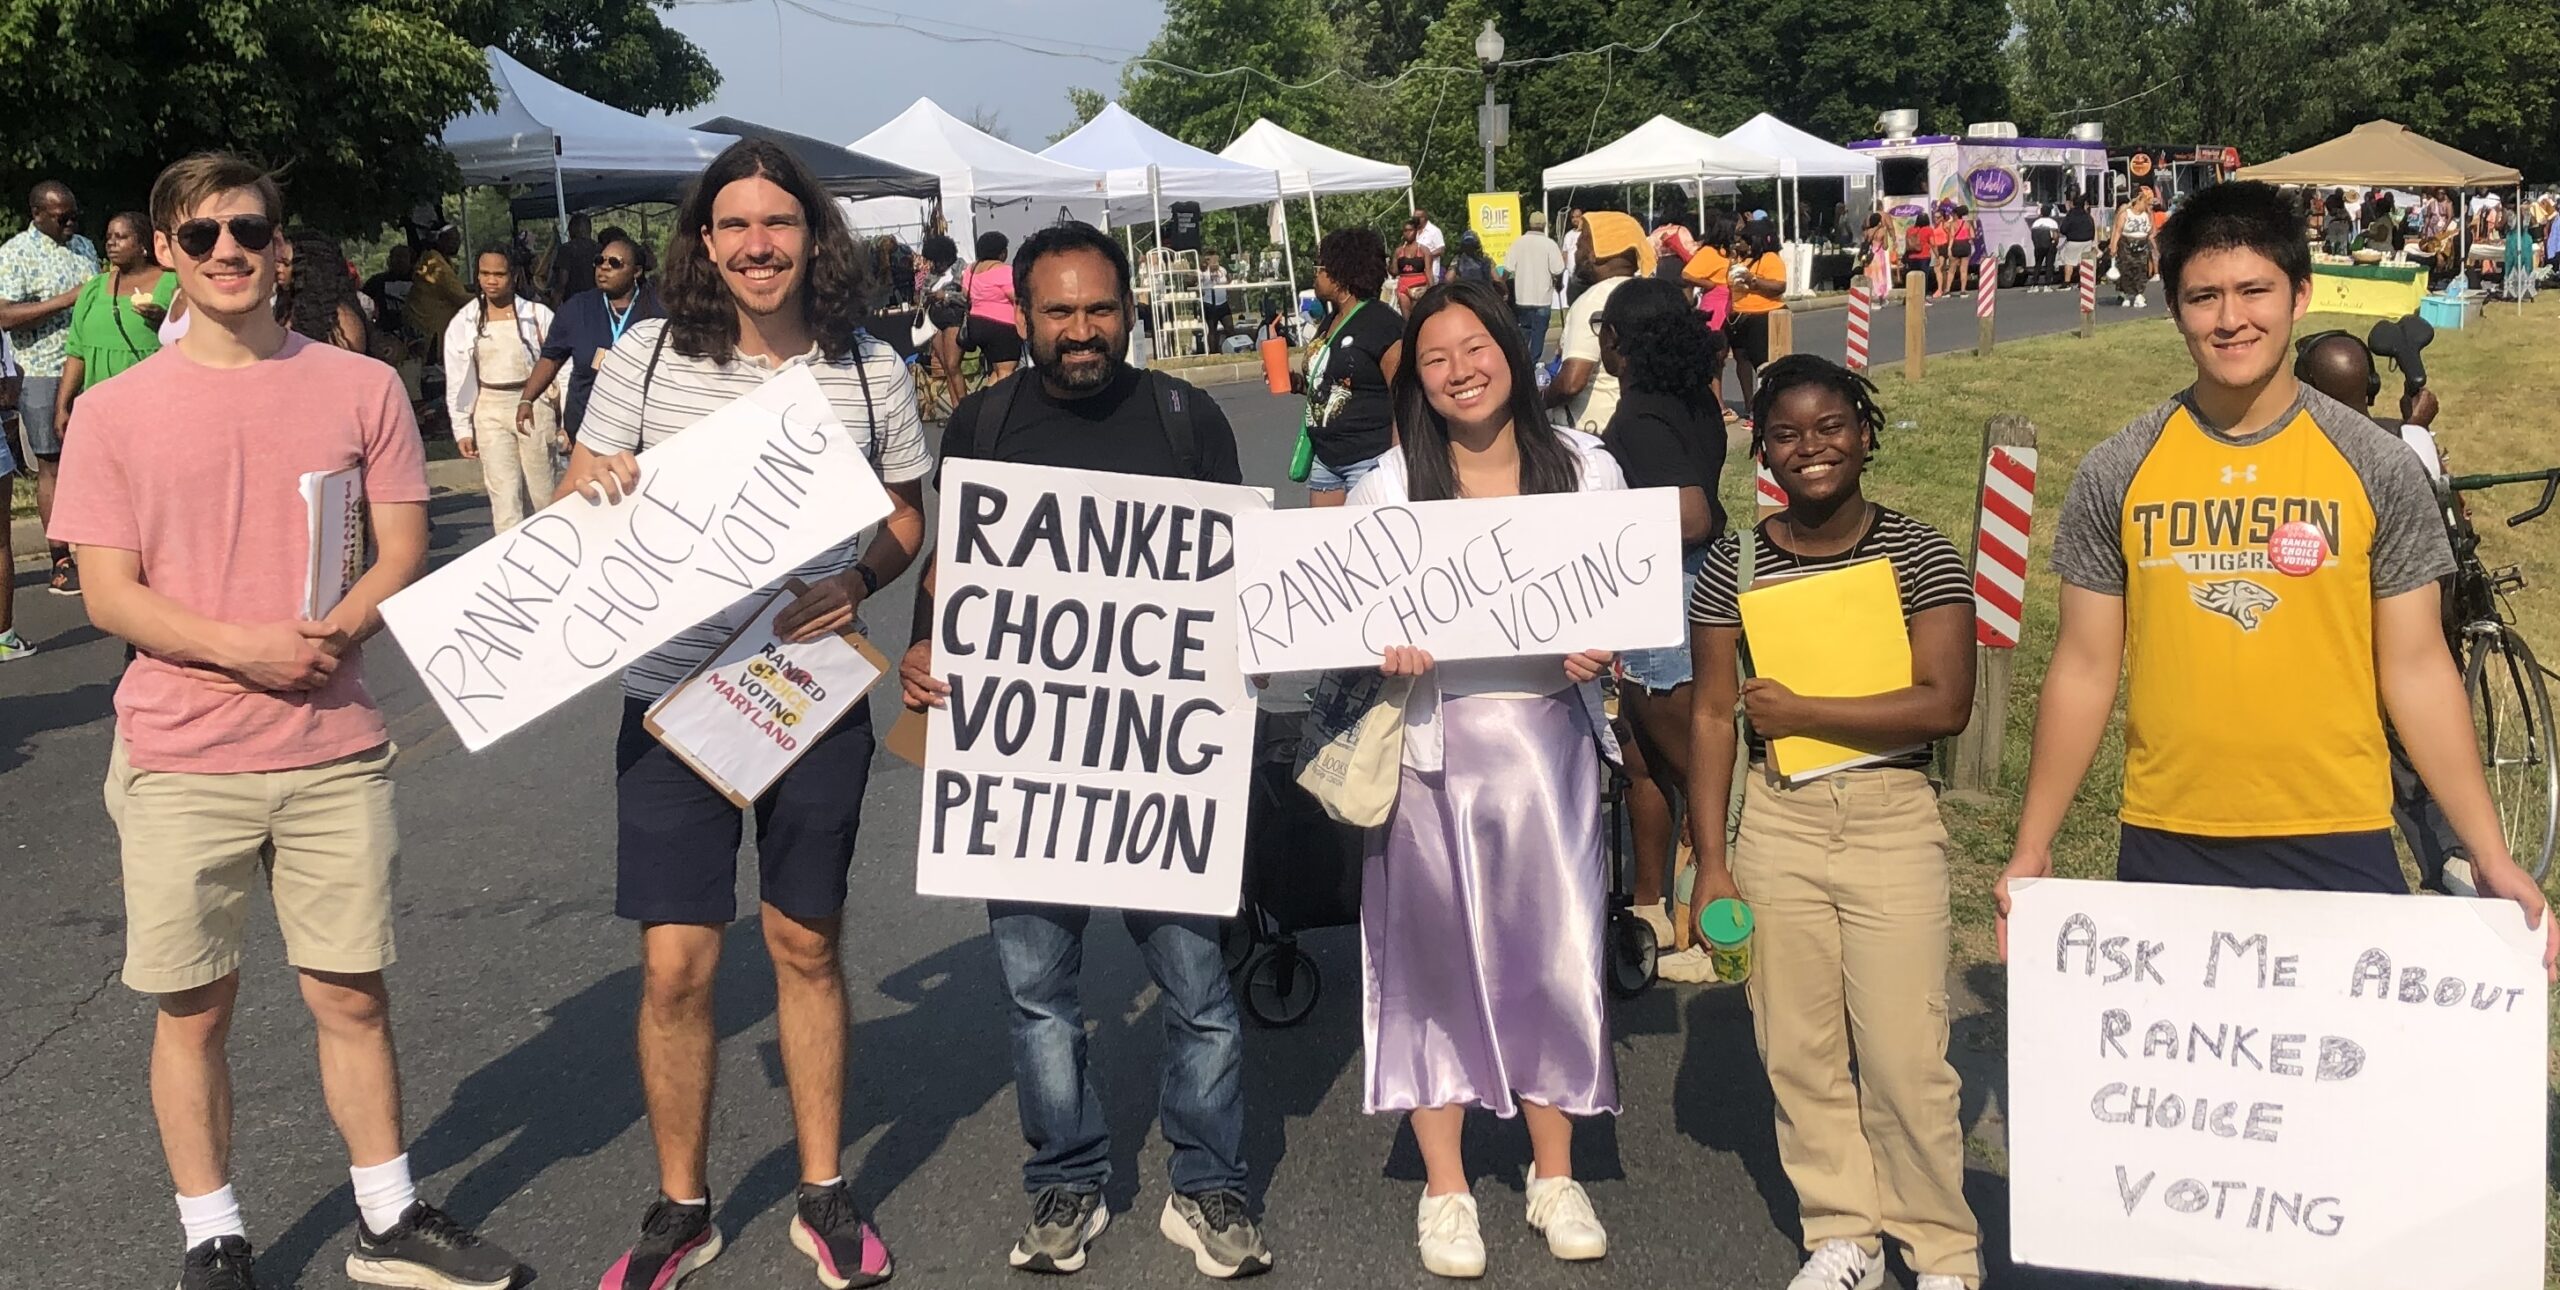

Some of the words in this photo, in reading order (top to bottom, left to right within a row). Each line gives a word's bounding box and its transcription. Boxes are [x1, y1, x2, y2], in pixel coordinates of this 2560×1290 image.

[696, 402, 828, 590] VOTING
[954, 481, 1235, 582] RANKED
[2133, 497, 2340, 557] TOWSON
[562, 468, 717, 669] CHOICE
[2187, 552, 2276, 571] TIGER
[2281, 538, 2320, 548] RANKED
[2281, 546, 2319, 558] CHOICE
[2283, 556, 2318, 566] VOTING
[425, 514, 582, 733] RANKED
[1238, 505, 1423, 666] RANKED
[1361, 518, 1535, 657] CHOICE
[1489, 522, 1657, 652] VOTING
[759, 641, 827, 703] RANKED
[941, 584, 1215, 681] CHOICE
[706, 672, 797, 751] MARYLAND
[738, 672, 799, 729] VOTING
[748, 661, 812, 714] CHOICE
[947, 673, 1225, 775] VOTING
[932, 769, 1217, 875] PETITION
[2056, 912, 2165, 986] ASK
[2350, 947, 2525, 1012] ABOUT
[2100, 1007, 2366, 1082] RANKED
[2091, 1082, 2284, 1143] CHOICE
[2115, 1165, 2344, 1237] VOTING
